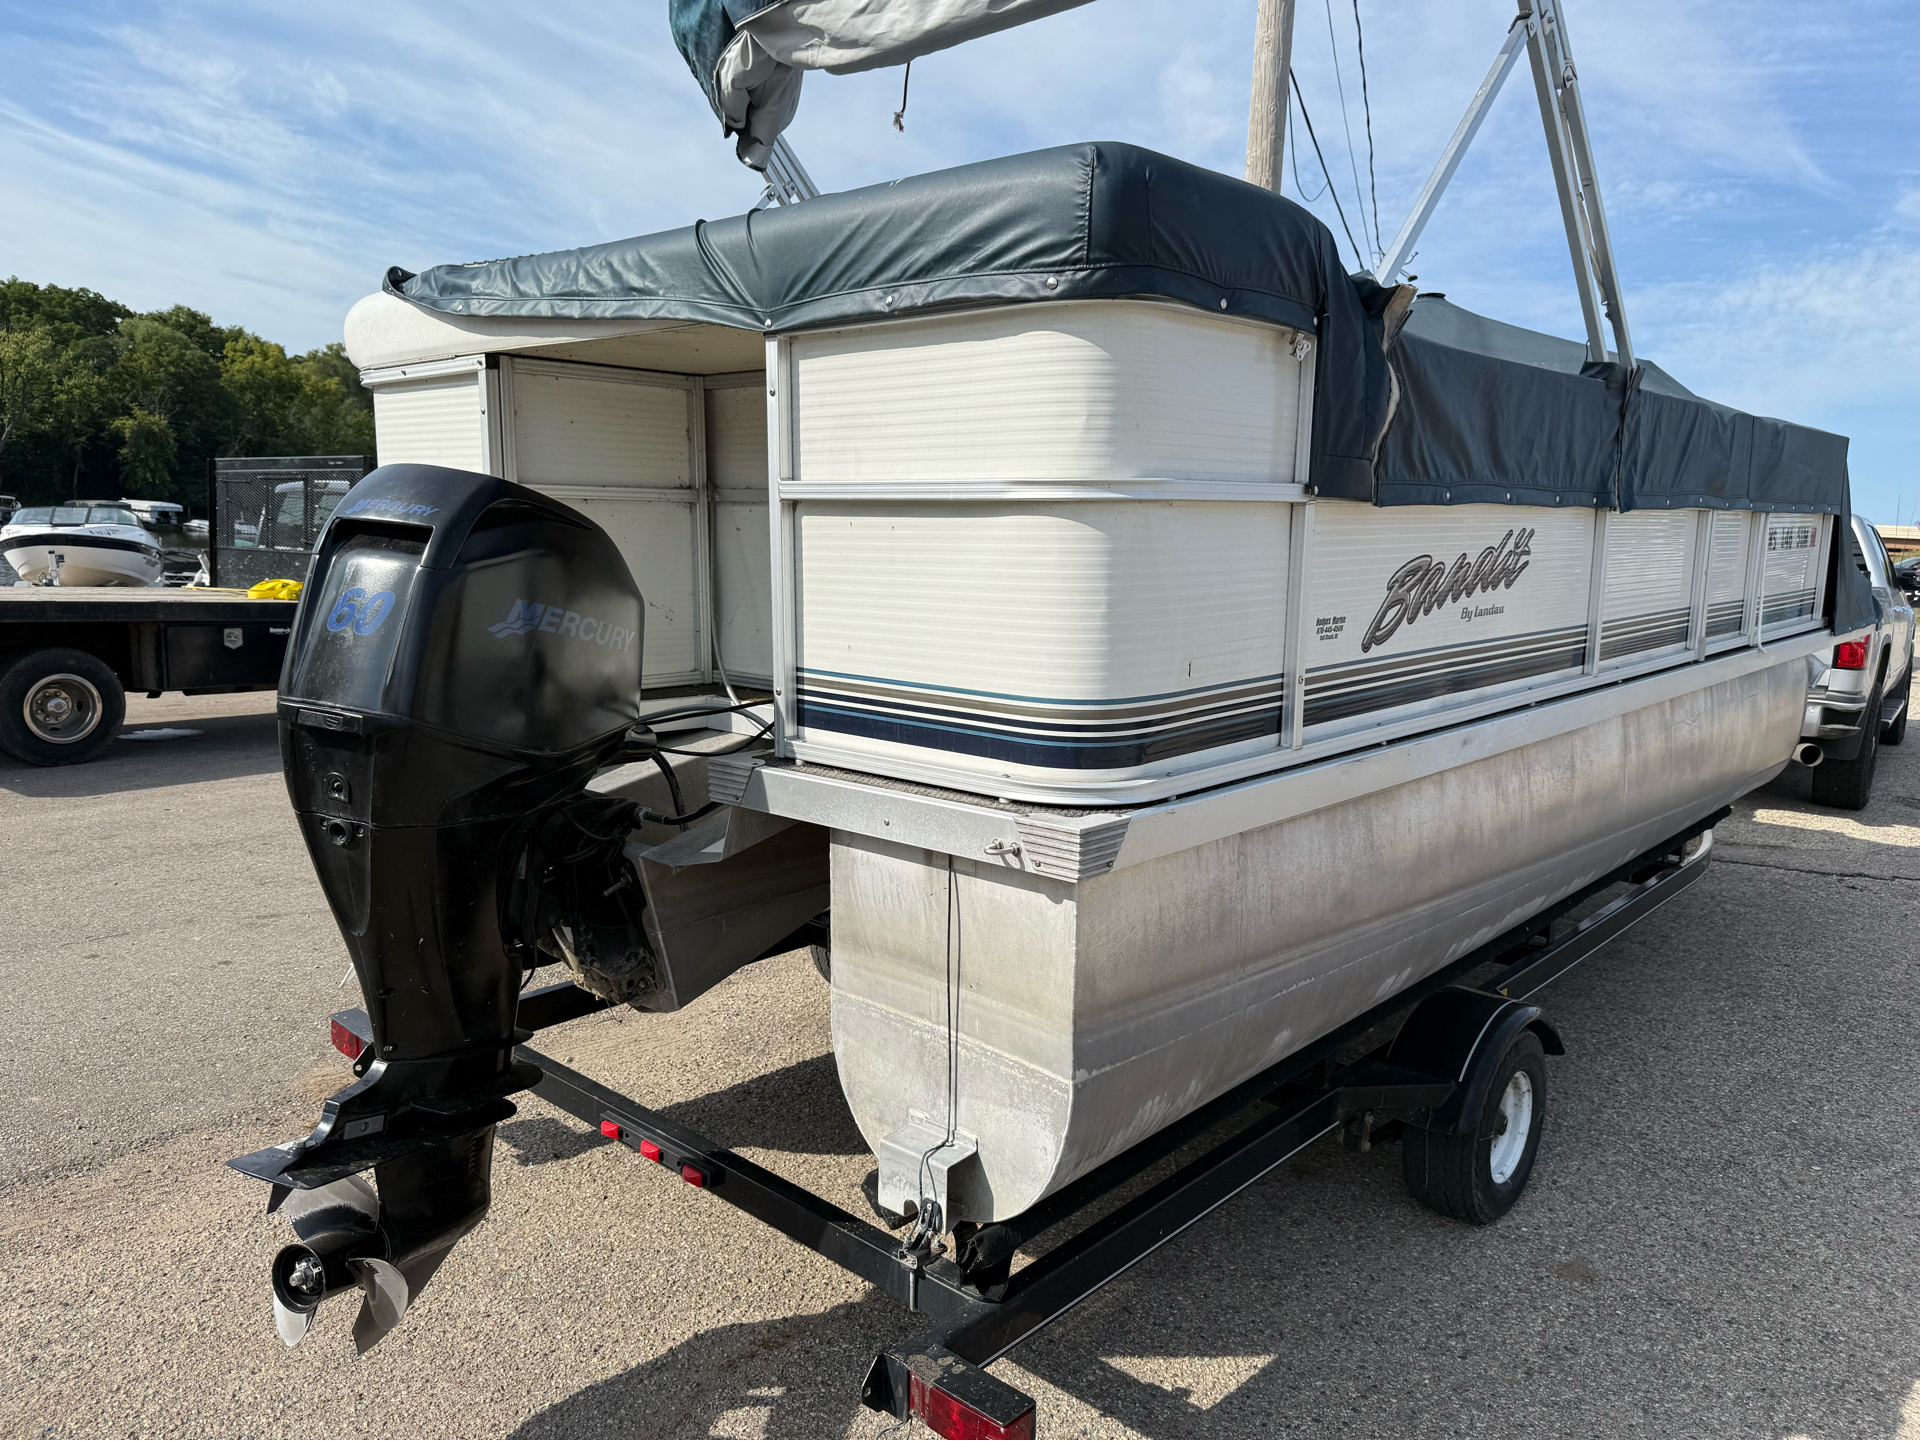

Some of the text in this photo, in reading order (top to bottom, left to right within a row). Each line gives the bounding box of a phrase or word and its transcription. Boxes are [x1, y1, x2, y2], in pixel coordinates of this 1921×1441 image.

[345, 499, 440, 517] MERCURY
[326, 587, 396, 635] 60
[1361, 527, 1535, 653] Bandit
[488, 599, 636, 652] MERCURY
[1460, 607, 1473, 623] By
